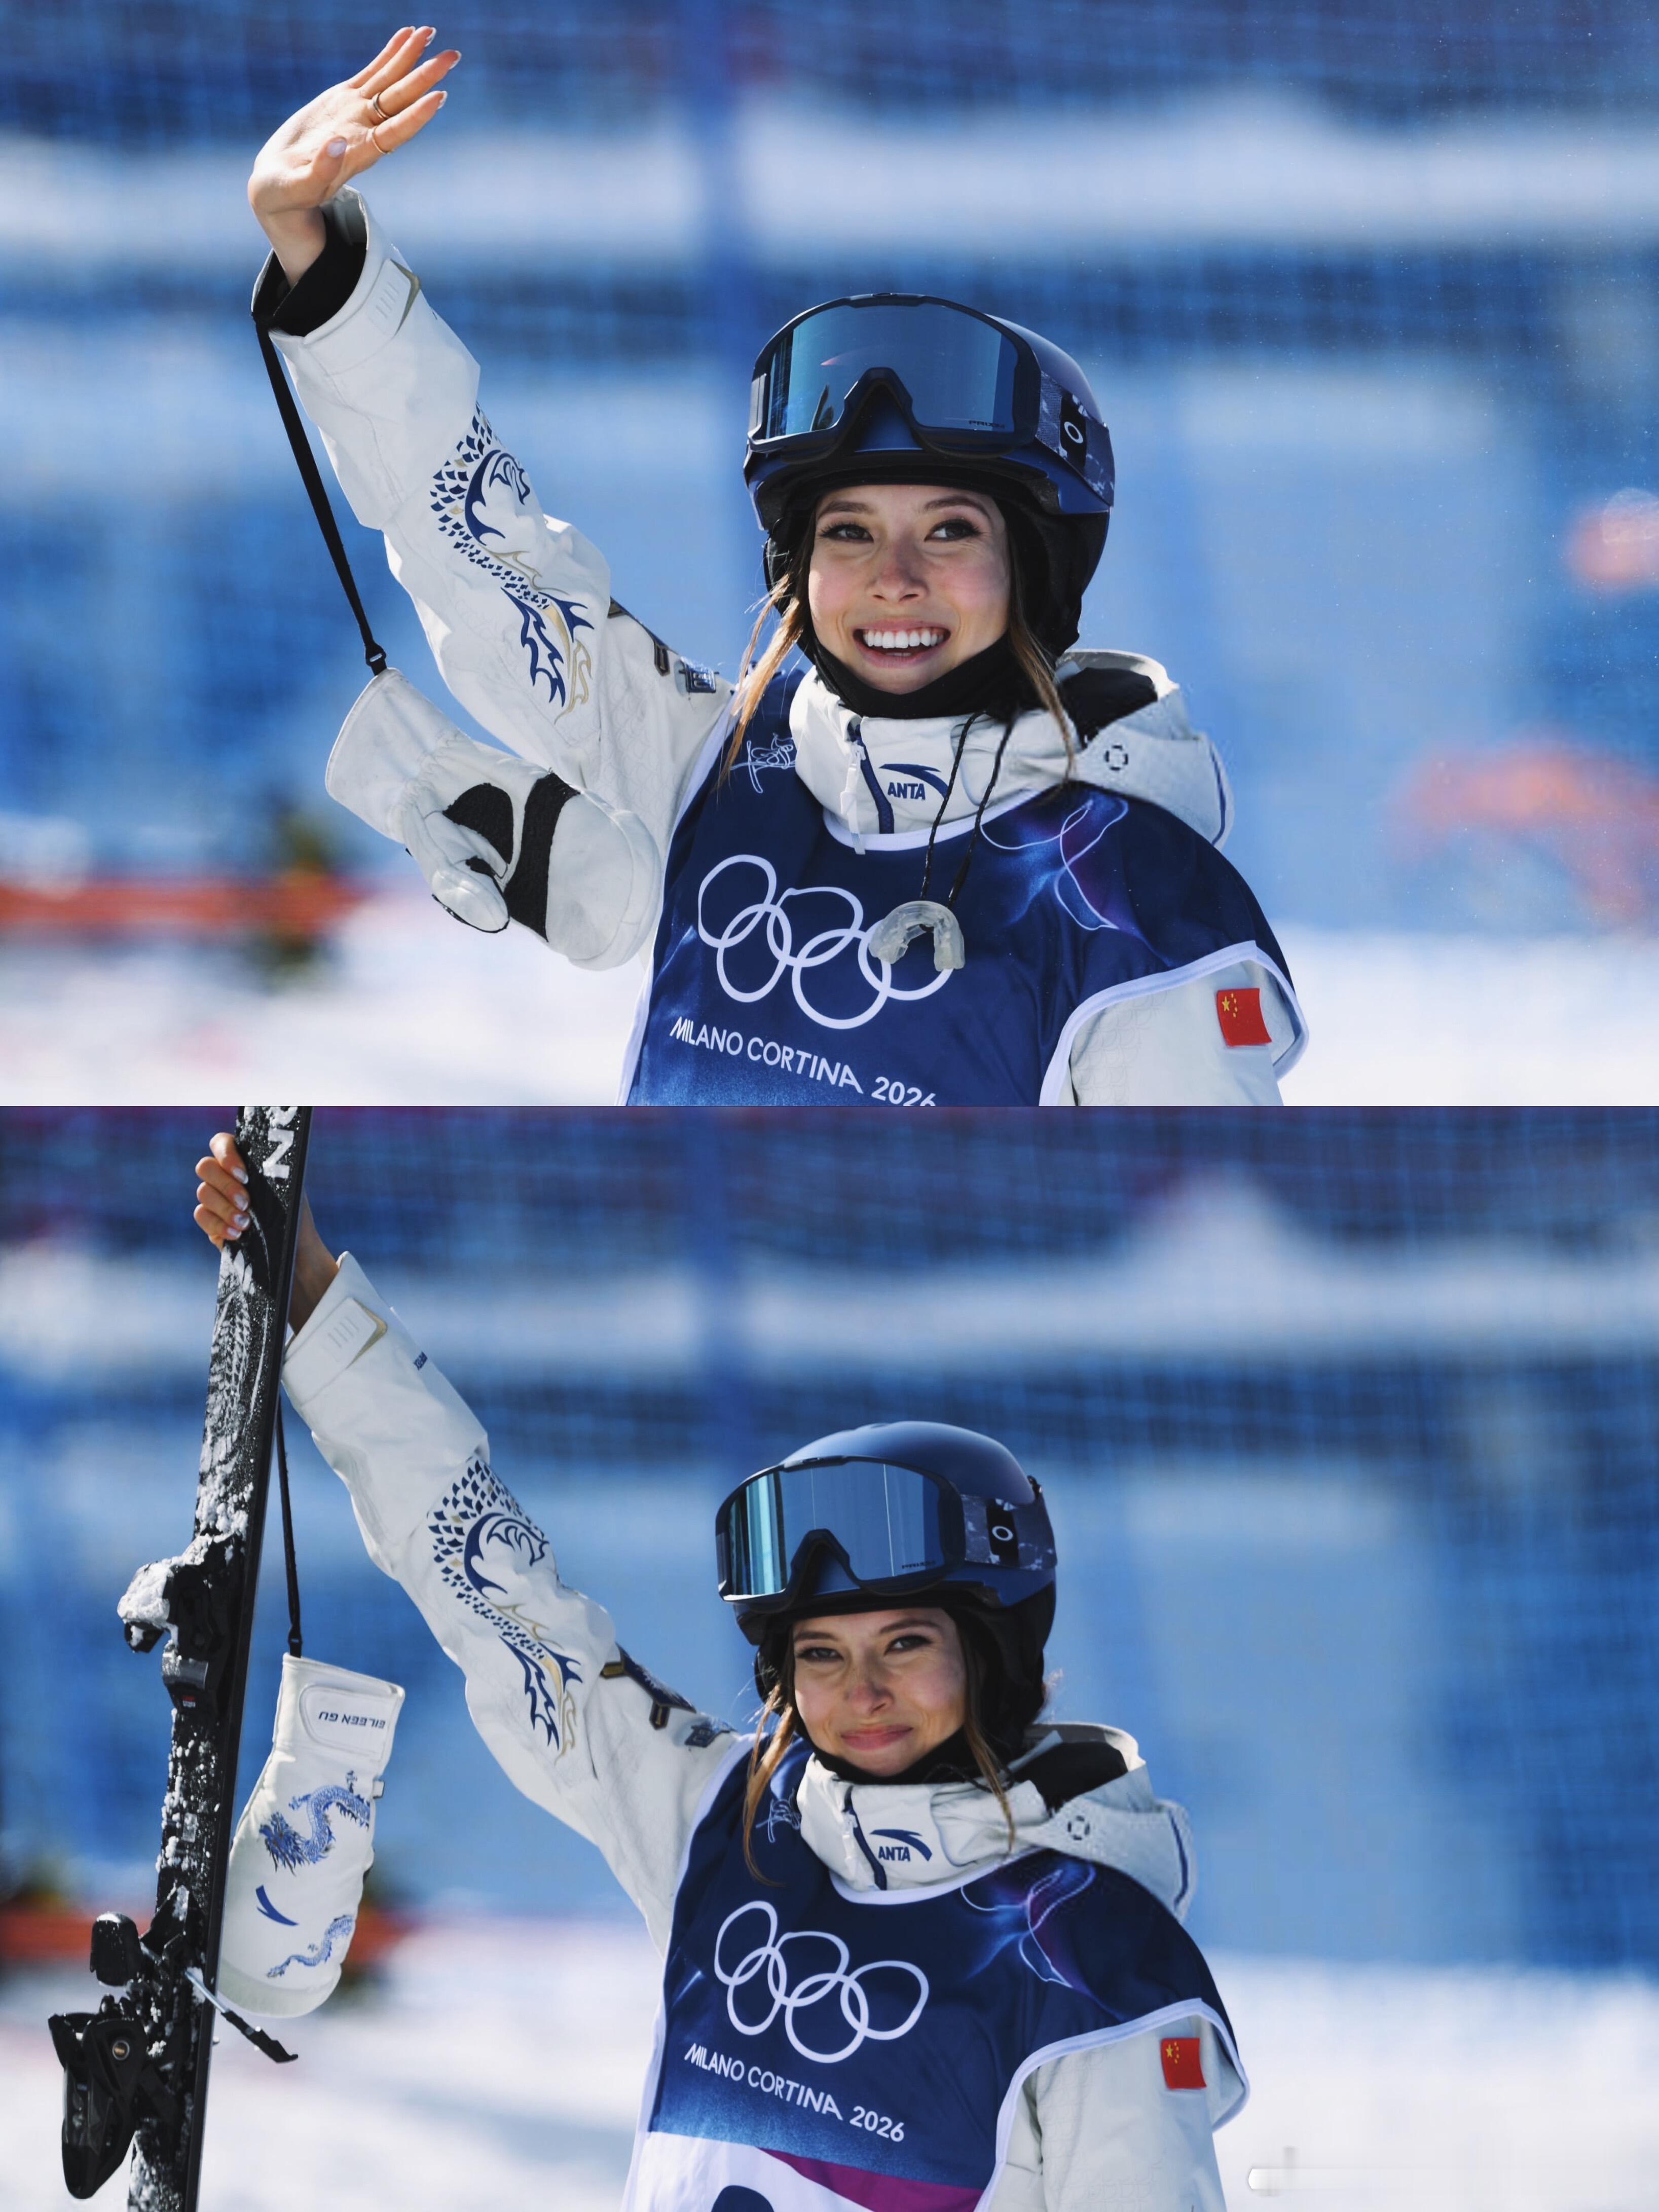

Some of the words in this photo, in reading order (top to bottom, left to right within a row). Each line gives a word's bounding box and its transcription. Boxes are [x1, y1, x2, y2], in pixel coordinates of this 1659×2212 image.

[888, 782, 926, 800] ANTA
[670, 1016, 743, 1055] MILANO
[747, 1037, 863, 1094] CORTINA
[318, 1711, 339, 1722] GU
[342, 1714, 386, 1729] EILEEN
[878, 1846, 911, 1862] ANTA
[684, 2043, 745, 2081] MILANO
[748, 2067, 843, 2120] CORTINA
[850, 2106, 905, 2142] 2026
